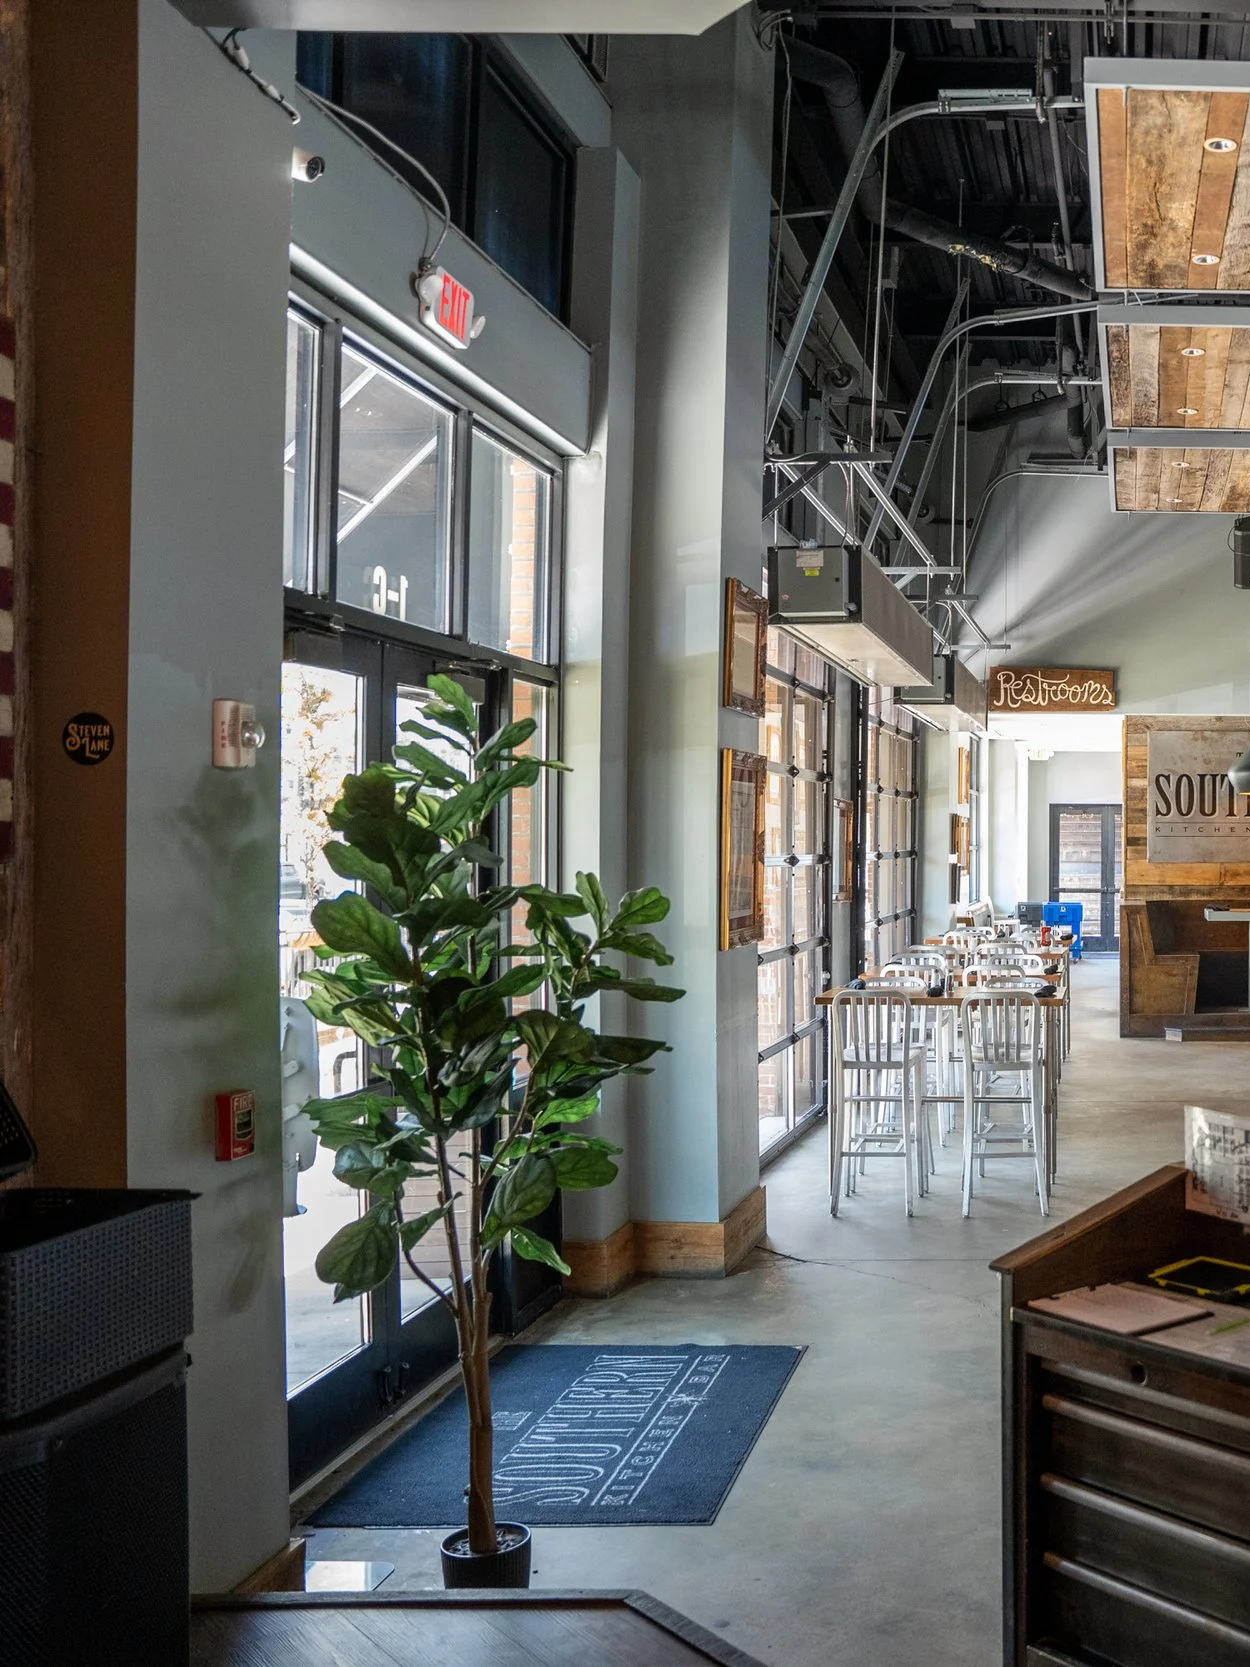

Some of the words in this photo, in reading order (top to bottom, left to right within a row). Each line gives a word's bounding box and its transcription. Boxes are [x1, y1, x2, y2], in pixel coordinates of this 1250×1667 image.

[439, 272, 471, 342] EXIT
[993, 670, 1115, 708] Restrooms
[65, 723, 110, 751] STEVEN
[81, 737, 110, 759] LANE
[233, 1094, 252, 1111] FIRE
[600, 1415, 684, 1506] KITCHEN
[688, 1354, 726, 1384] BAR
